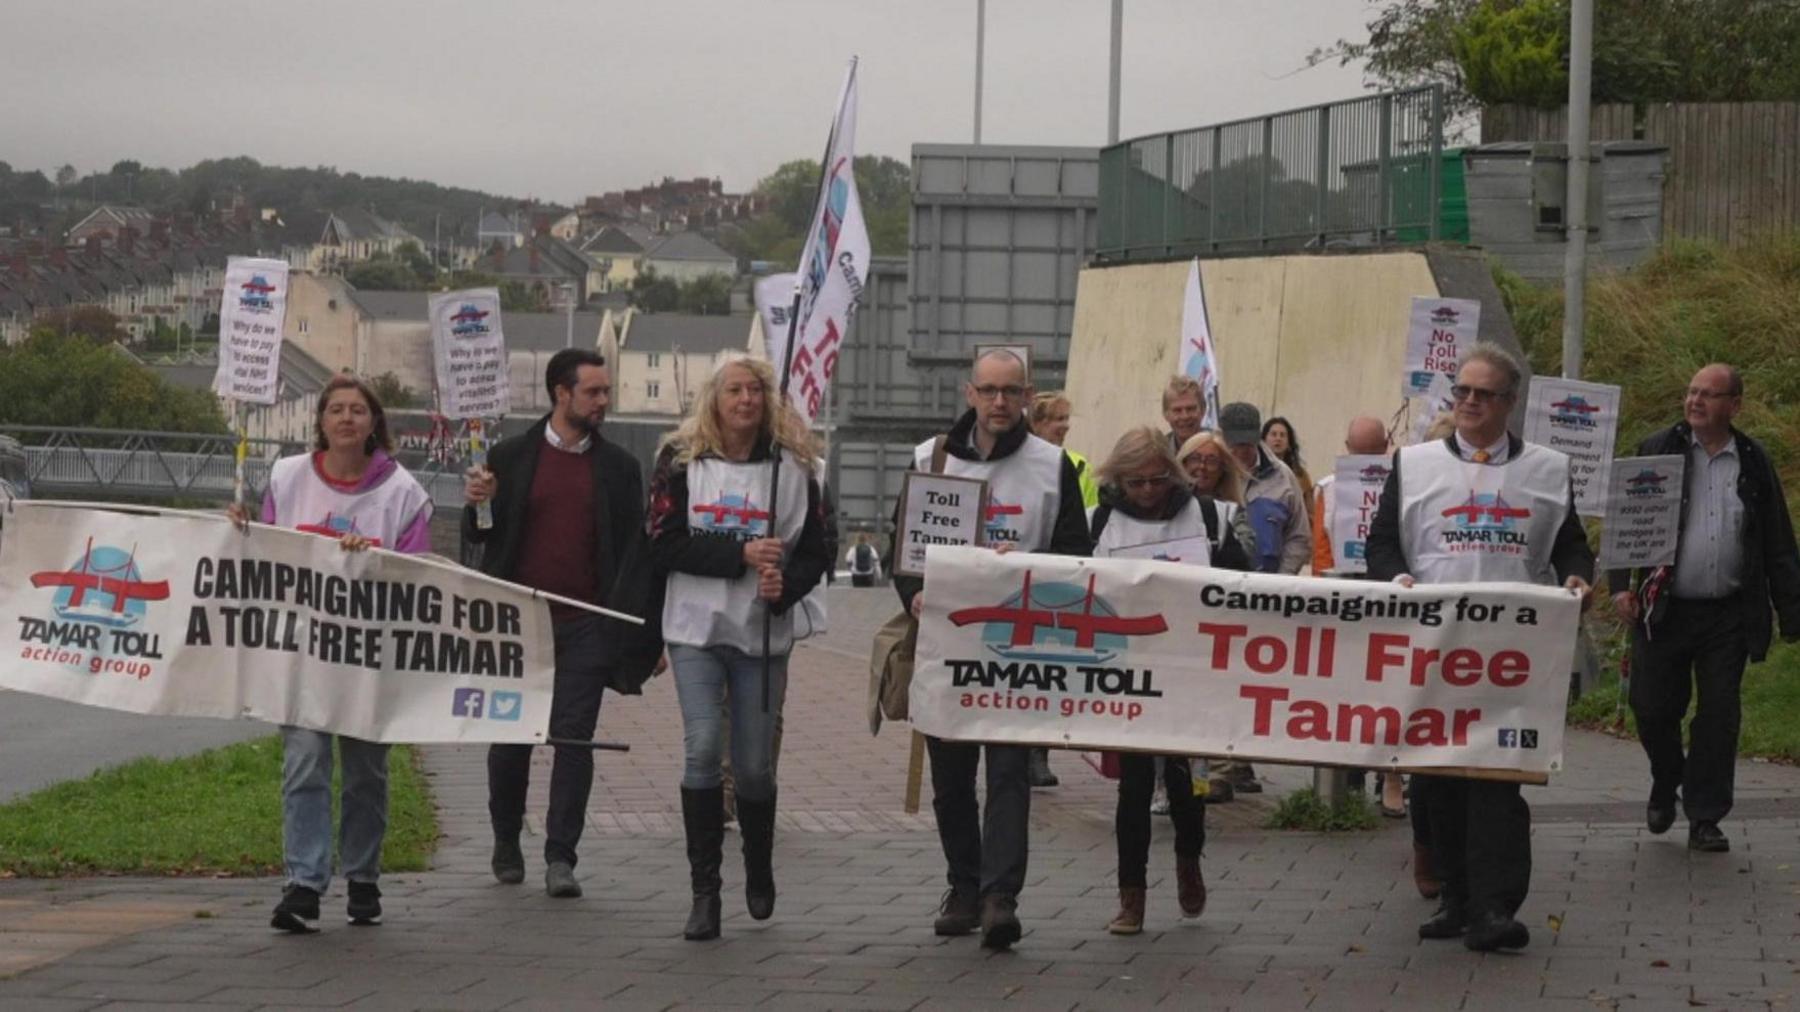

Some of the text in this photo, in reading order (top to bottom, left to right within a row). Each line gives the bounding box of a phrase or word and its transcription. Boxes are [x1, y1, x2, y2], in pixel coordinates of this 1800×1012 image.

[233, 320, 276, 335] Why do we
[231, 335, 274, 352] have to pay
[1433, 329, 1455, 343] No
[450, 349, 471, 359] Why
[485, 347, 498, 355] we
[1428, 342, 1457, 358] Toll
[242, 354, 269, 365] access
[451, 363, 474, 373] have
[484, 360, 500, 371] pay
[1425, 357, 1457, 372] Rise
[249, 369, 268, 379] NHS
[456, 376, 467, 386] to
[233, 383, 268, 395] services?
[1551, 436, 1593, 449] Demand
[1581, 464, 1597, 475] for
[926, 490, 961, 508] Toll
[1644, 504, 1670, 514] other
[921, 511, 961, 528] Free
[1632, 516, 1655, 526] road
[909, 529, 968, 547] Tamar
[986, 528, 1020, 542] TOLL
[1441, 529, 1528, 546] TAMAR TOLL
[1618, 526, 1666, 540] bridges in
[1450, 543, 1521, 554] action group
[1616, 540, 1666, 550] the UK are
[192, 556, 521, 636] CAMPAIGNING FOR
[1200, 584, 1538, 627] Campaigning for a
[18, 616, 162, 659] TAMAR TOLL
[185, 606, 523, 679] A TOLL FREE TAMAR
[1198, 622, 1530, 688] Toll Free
[21, 646, 152, 681] action group
[944, 660, 1163, 698] TAMAR TOLL
[960, 690, 1142, 720] action group
[1239, 684, 1481, 747] Tamar
